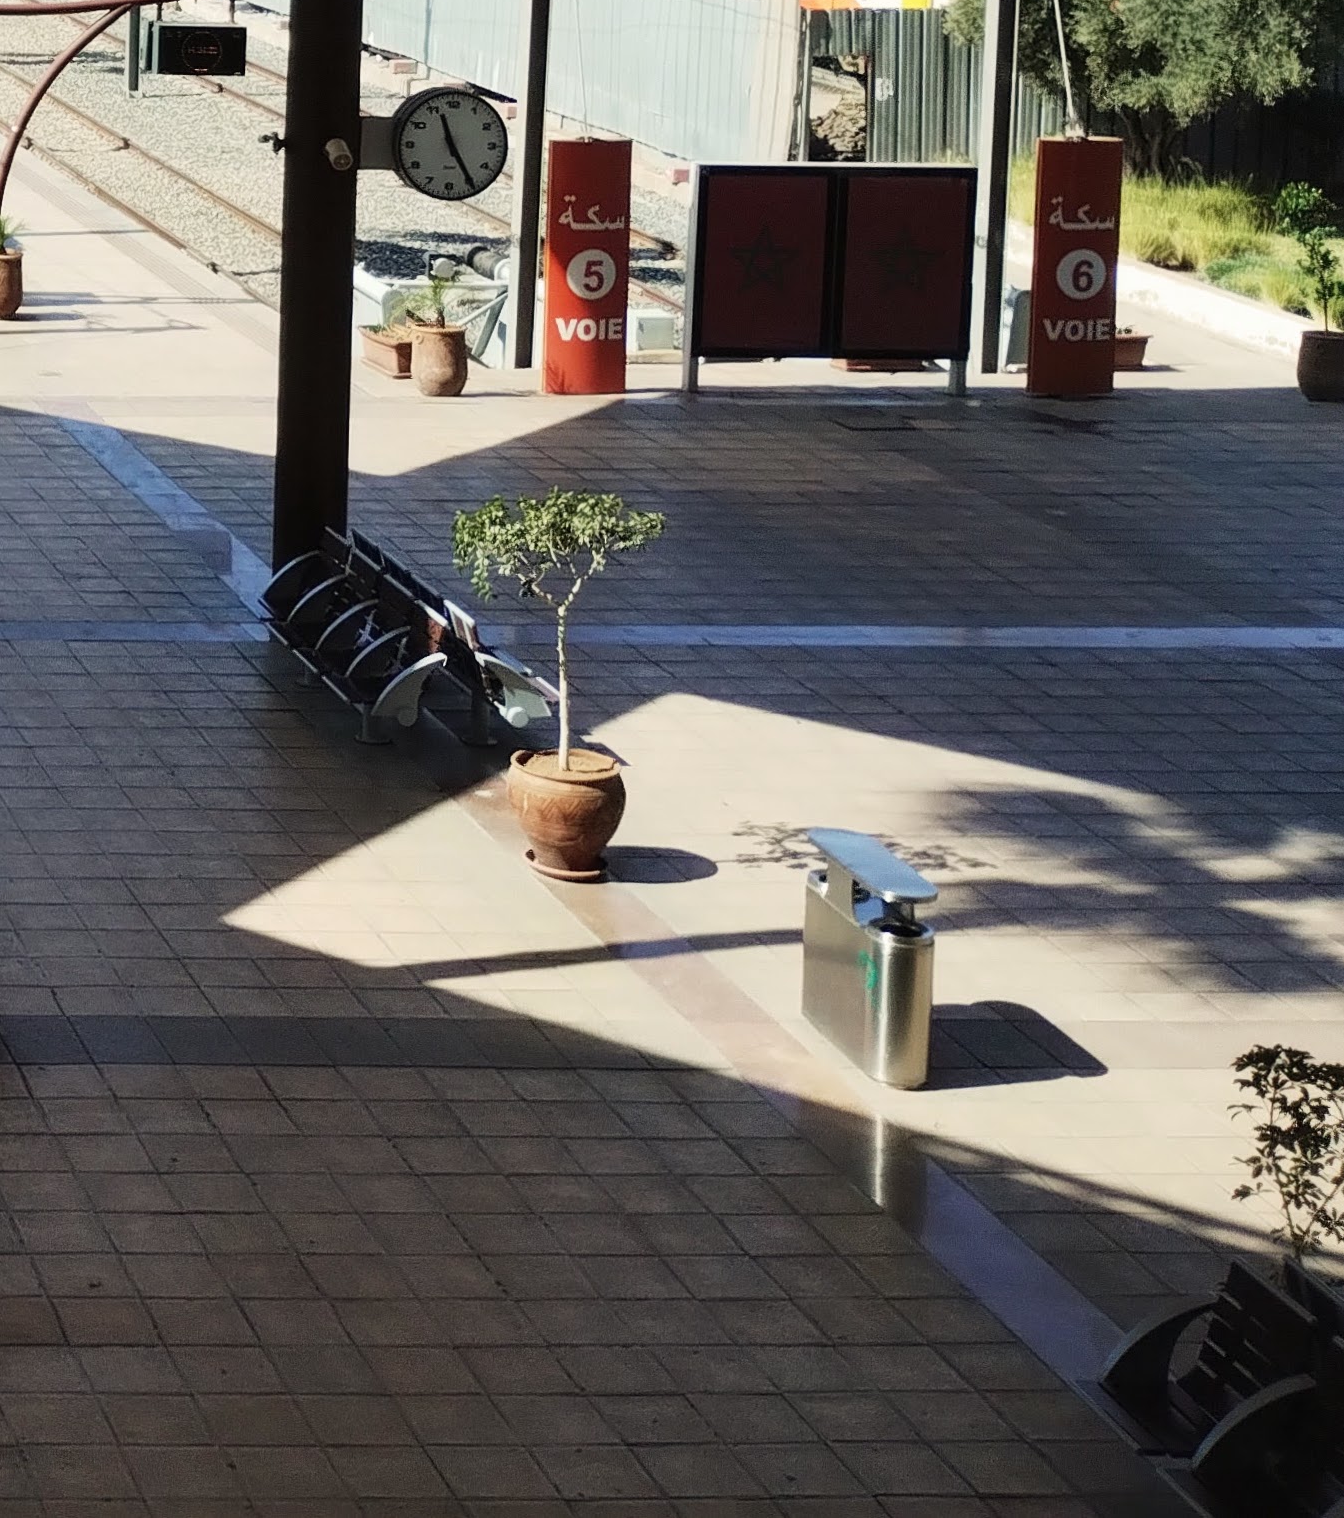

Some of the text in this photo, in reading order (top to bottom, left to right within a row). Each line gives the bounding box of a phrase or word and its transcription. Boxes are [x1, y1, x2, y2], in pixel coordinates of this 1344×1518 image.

[558, 195, 625, 231] سكة
[1049, 196, 1114, 230] سكة
[583, 260, 604, 293] 5
[1071, 260, 1094, 293] 6
[555, 318, 623, 342] VOIE
[1042, 319, 1111, 342] VOIE
